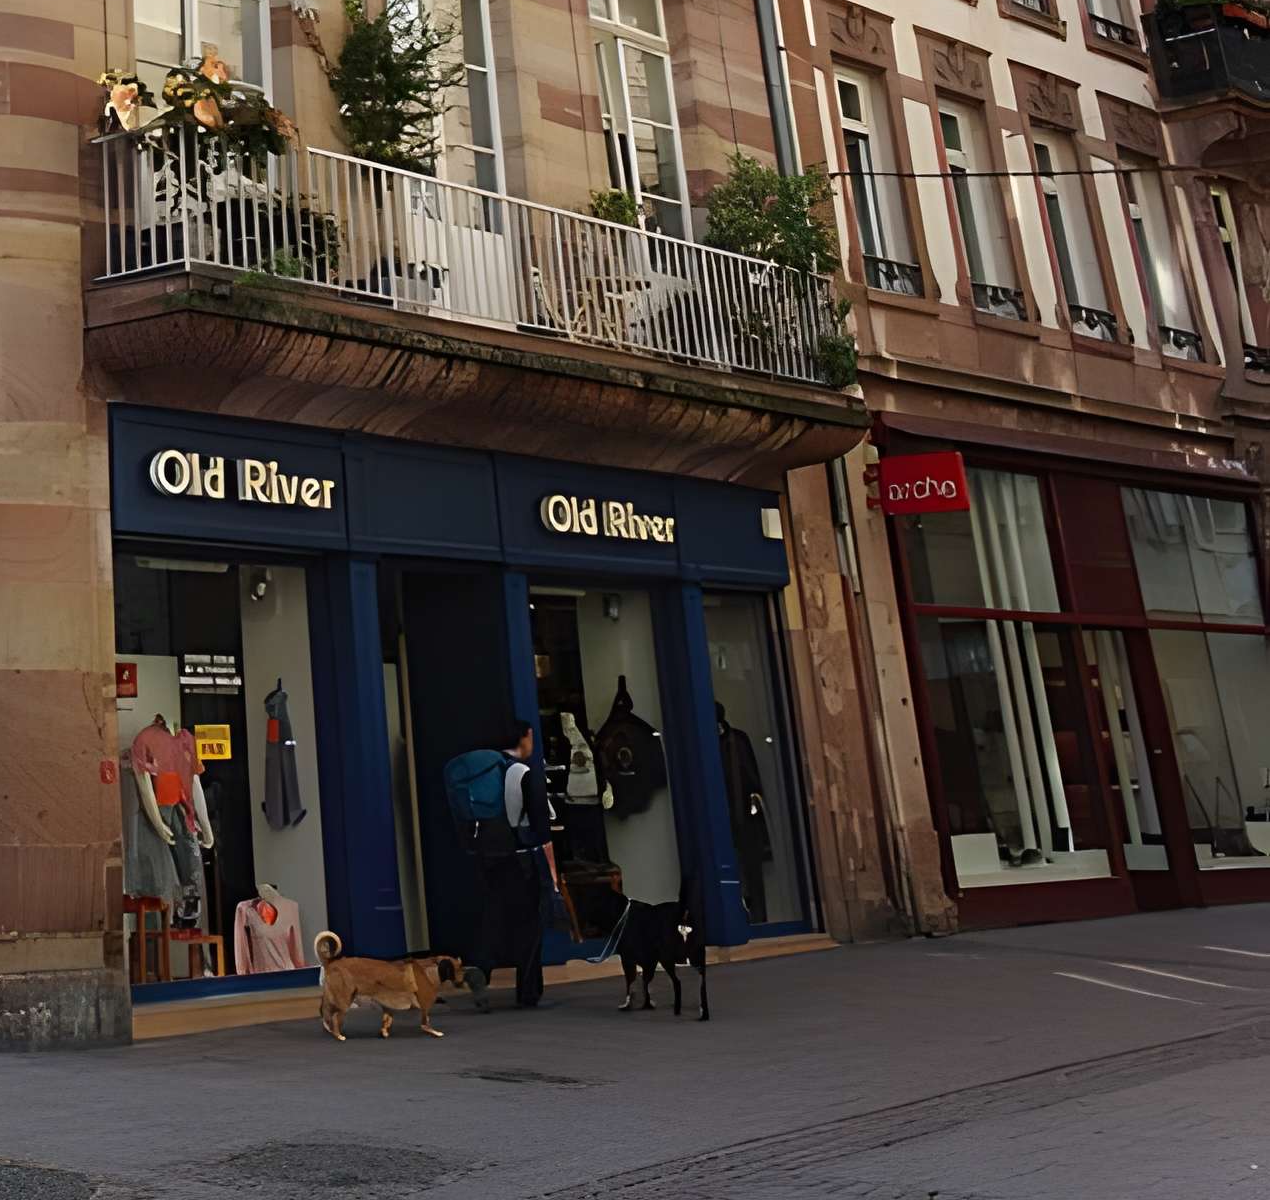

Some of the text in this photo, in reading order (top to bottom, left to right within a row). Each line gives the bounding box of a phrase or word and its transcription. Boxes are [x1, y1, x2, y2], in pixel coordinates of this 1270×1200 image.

[149, 449, 335, 509] Old River
[540, 494, 675, 543] Old River
